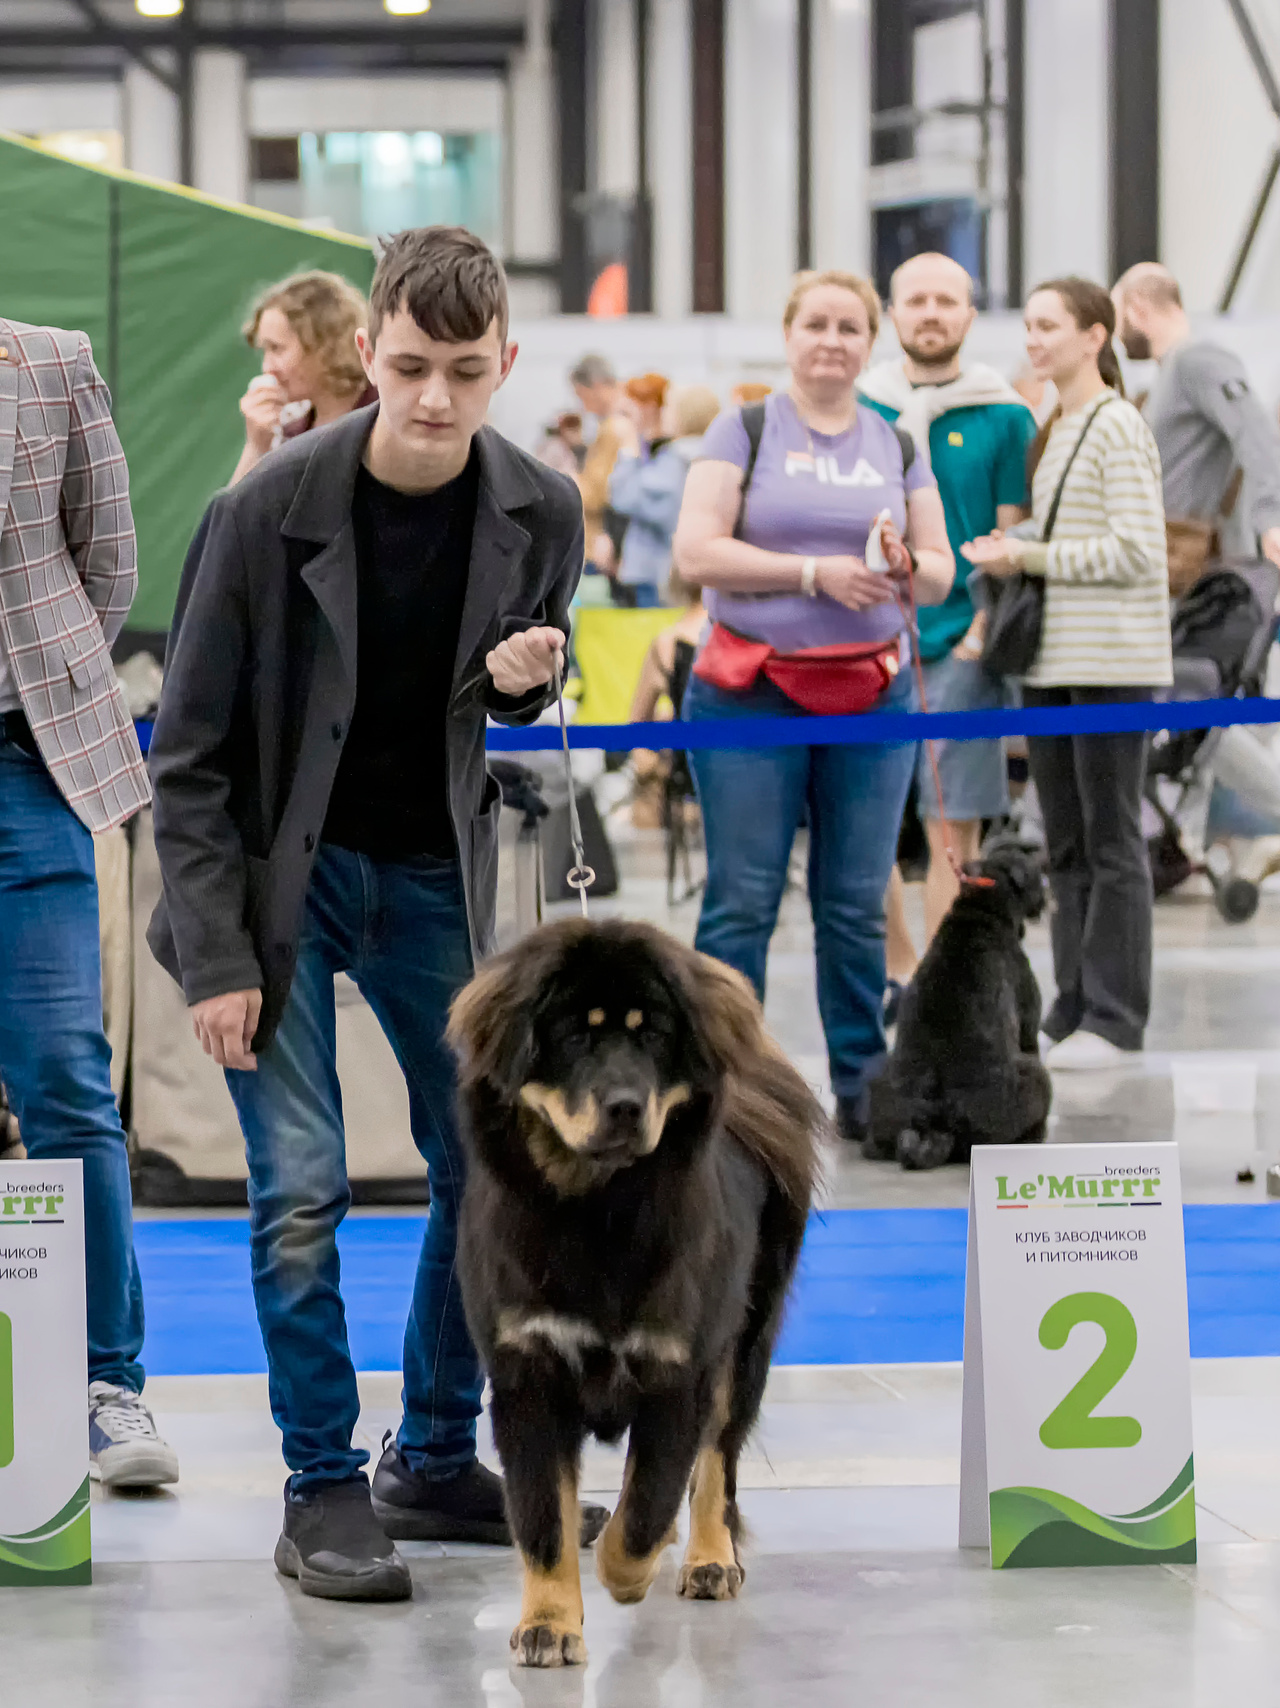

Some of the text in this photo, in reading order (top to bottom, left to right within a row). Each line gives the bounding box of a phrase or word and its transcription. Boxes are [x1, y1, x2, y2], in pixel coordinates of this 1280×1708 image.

[785, 450, 885, 487] FILA
[1104, 1165, 1161, 1176] breeders
[6, 1182, 64, 1193] breeders
[995, 1174, 1161, 1200] Le'Murrr
[1015, 1230, 1147, 1244] КЛУБ ЗАВОДЧИКОВ
[1026, 1250, 1138, 1263] И ПИТОМНИКОВ
[1038, 1291, 1143, 1450] 2
